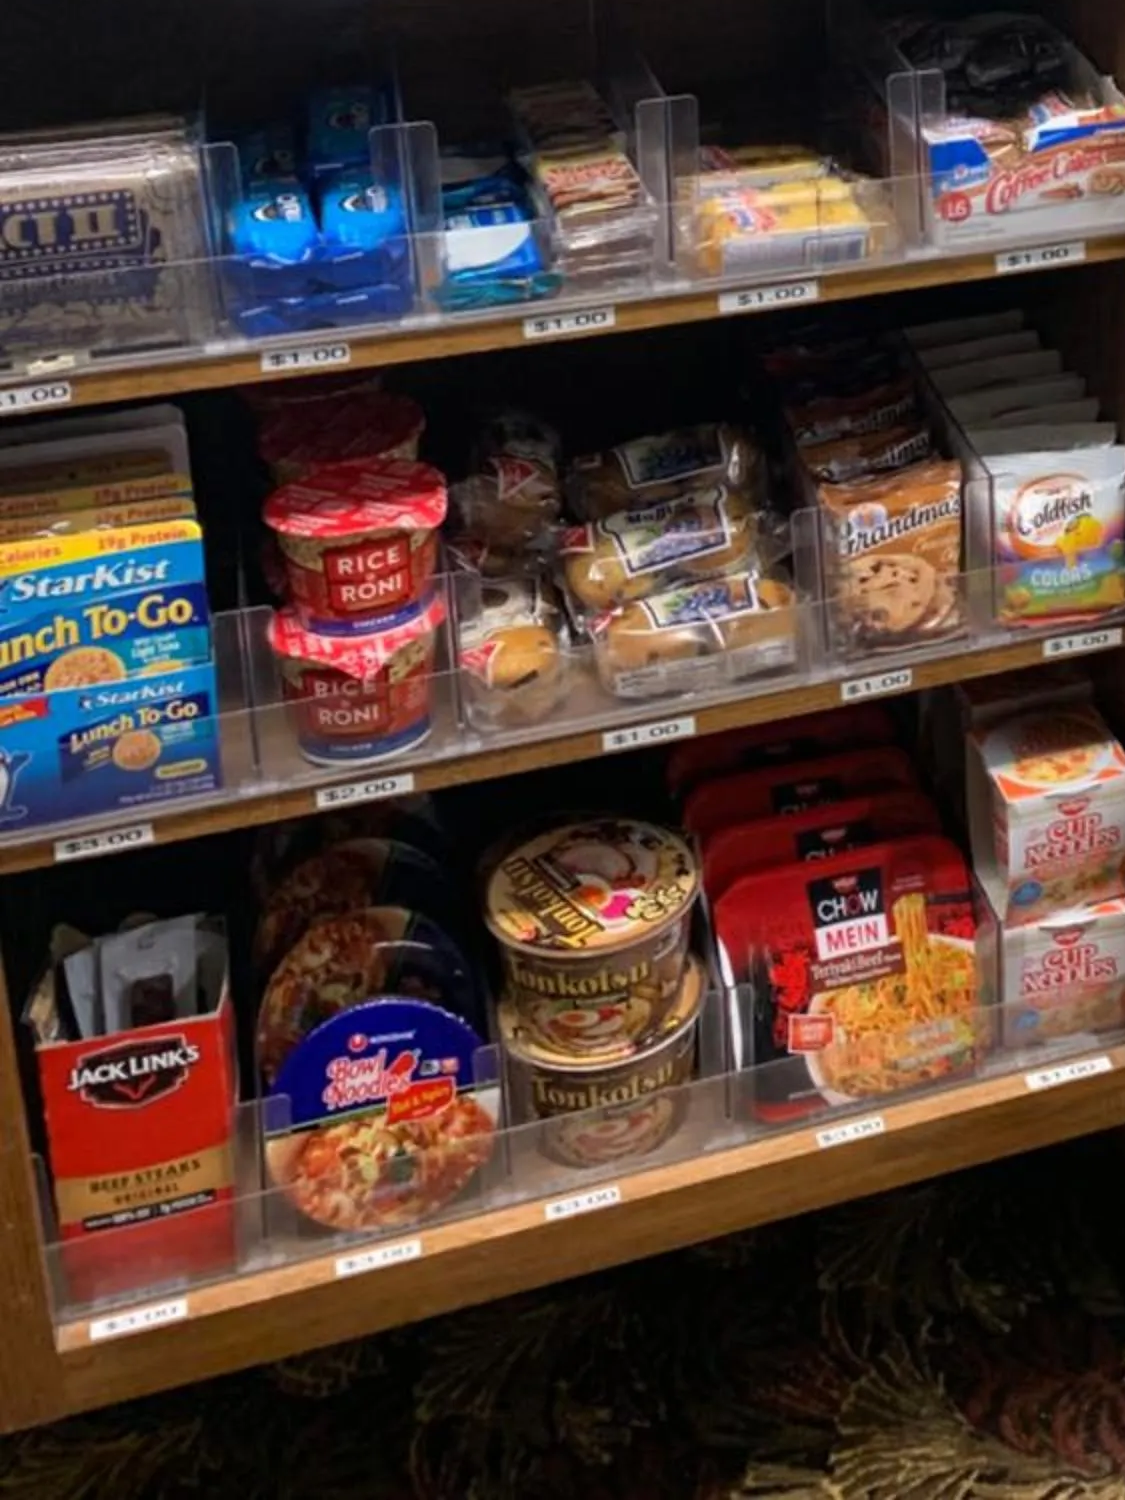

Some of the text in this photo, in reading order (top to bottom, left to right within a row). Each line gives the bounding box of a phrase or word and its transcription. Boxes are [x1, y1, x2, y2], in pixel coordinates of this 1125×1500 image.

[1007, 247, 1070, 266] $1.00
[737, 285, 806, 306] $1.00
[534, 311, 607, 333] $1.00
[269, 346, 347, 368] $1.00
[0, 384, 68, 407] 1.00
[1016, 491, 1093, 536] Goldfish
[131, 527, 190, 545] Protein
[337, 546, 401, 576] RICE
[10, 558, 172, 602] StarKist
[340, 575, 403, 603] RONI
[1030, 563, 1093, 588] COLORS
[0, 614, 80, 668] unch
[95, 680, 186, 709] StarKist
[313, 679, 378, 698] RICE
[846, 672, 909, 696] $1.00
[317, 704, 380, 726] RONI
[70, 711, 135, 753] Lunch
[611, 722, 681, 745] $1.00
[323, 779, 399, 802] $2.00
[1046, 812, 1102, 845] CUP
[1024, 825, 1120, 869] NOODLES
[816, 889, 879, 922] CHOW
[824, 921, 880, 953] MEIN
[1042, 943, 1098, 974] CUP
[1020, 959, 1118, 996] NOODLES
[67, 1045, 201, 1090] JACK LINK'S
[90, 1159, 202, 1195] BEEF STEAKS
[114, 1182, 181, 1205] ORIGINAL
